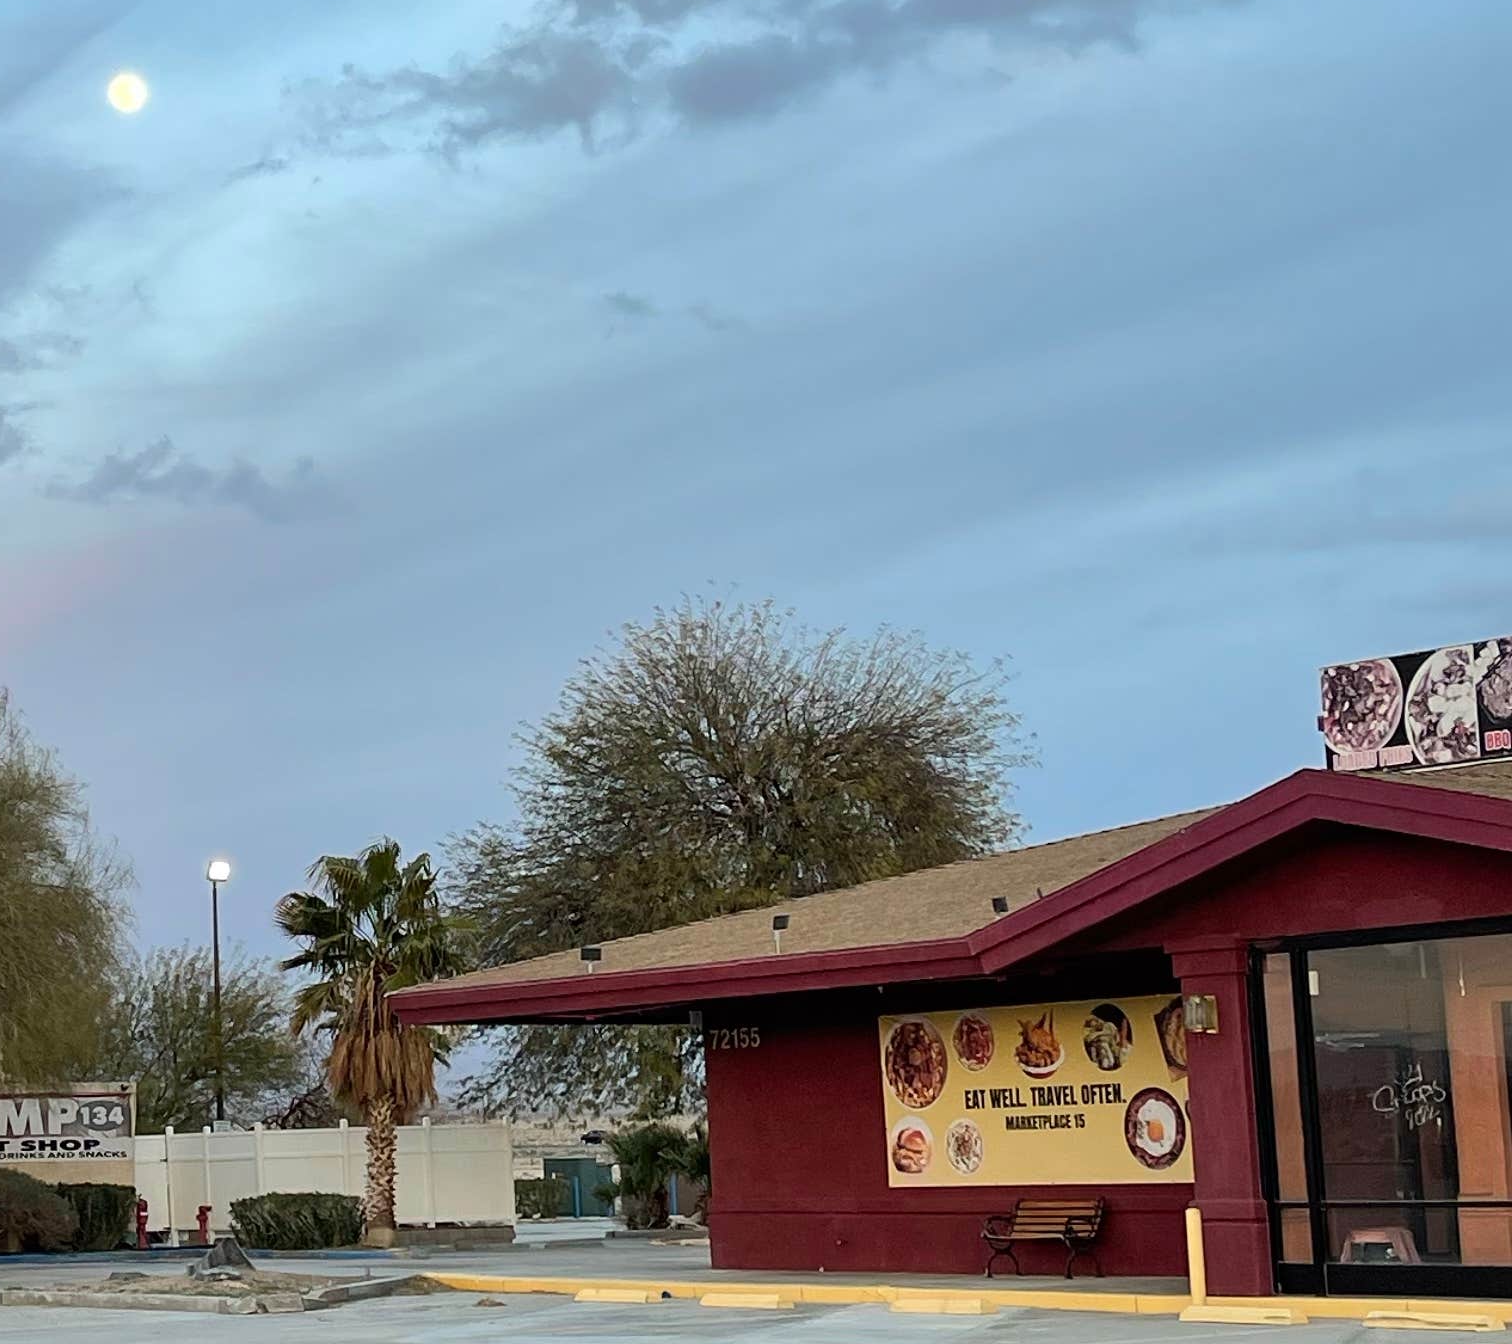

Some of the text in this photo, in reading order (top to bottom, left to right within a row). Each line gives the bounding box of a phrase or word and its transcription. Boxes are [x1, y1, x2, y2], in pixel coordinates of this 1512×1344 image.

[709, 1027, 761, 1050] 72155
[965, 1089, 986, 1109] EAT
[1030, 1085, 1078, 1107] TRAVEL
[1081, 1083, 1128, 1105] OFTEN.
[79, 1105, 124, 1126] 134
[1005, 1114, 1086, 1130] MARKETPLACE 15
[20, 1139, 100, 1152] SHOP
[48, 1151, 75, 1159] AND
[78, 1150, 127, 1159] SNACKS
